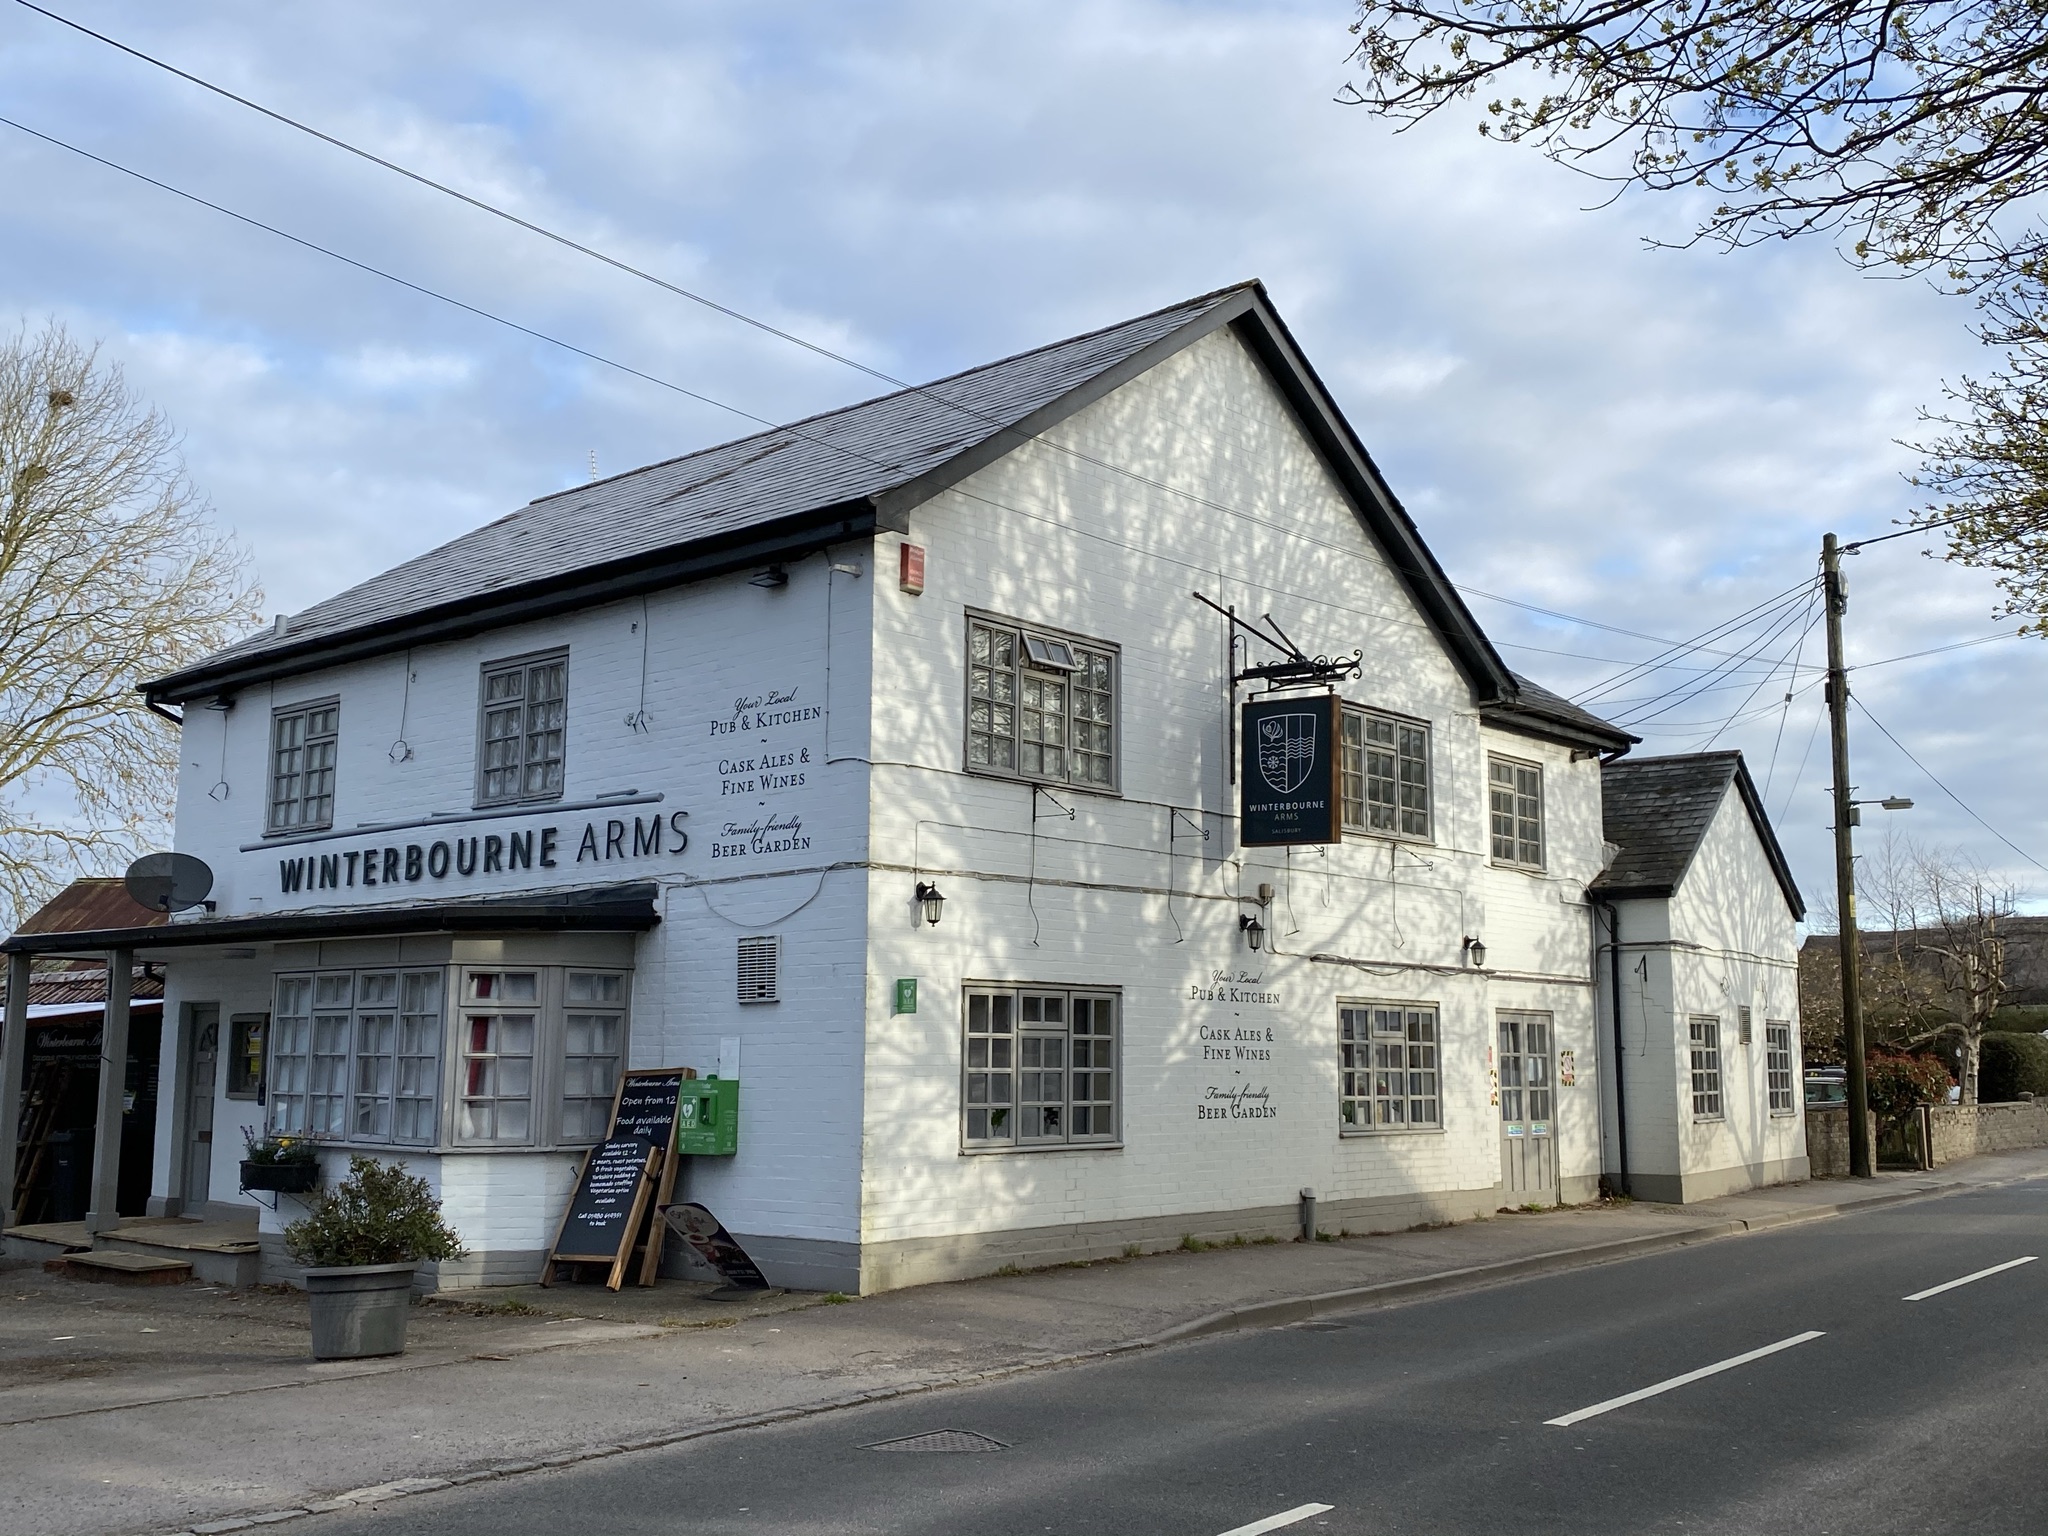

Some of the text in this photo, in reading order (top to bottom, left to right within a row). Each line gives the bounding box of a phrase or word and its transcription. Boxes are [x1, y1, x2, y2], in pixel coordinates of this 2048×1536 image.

[734, 686, 798, 720] Your Local
[741, 715, 751, 731] &
[756, 706, 822, 729] KITCHEN
[718, 747, 811, 775] CASK ALES &
[721, 773, 805, 796] FINE WINES
[1249, 800, 1324, 812] WINTERBOURNE
[1274, 813, 1299, 821] ARMS
[1272, 827, 1302, 835] SALISBURY
[279, 811, 690, 893] WINTERBOURNE ARMS
[711, 837, 811, 858] BEER GARDEN
[1210, 970, 1262, 990] Your Local
[1217, 987, 1226, 1001] &
[1230, 988, 1280, 1004] KITCHEN
[1200, 1025, 1274, 1042] CASK ALES &
[1203, 1046, 1270, 1060] FINE WINES
[622, 1095, 676, 1107] Open from 12
[1198, 1104, 1277, 1119] BEER GARDEN
[616, 1115, 672, 1126] Food available
[633, 1125, 652, 1136] daily
